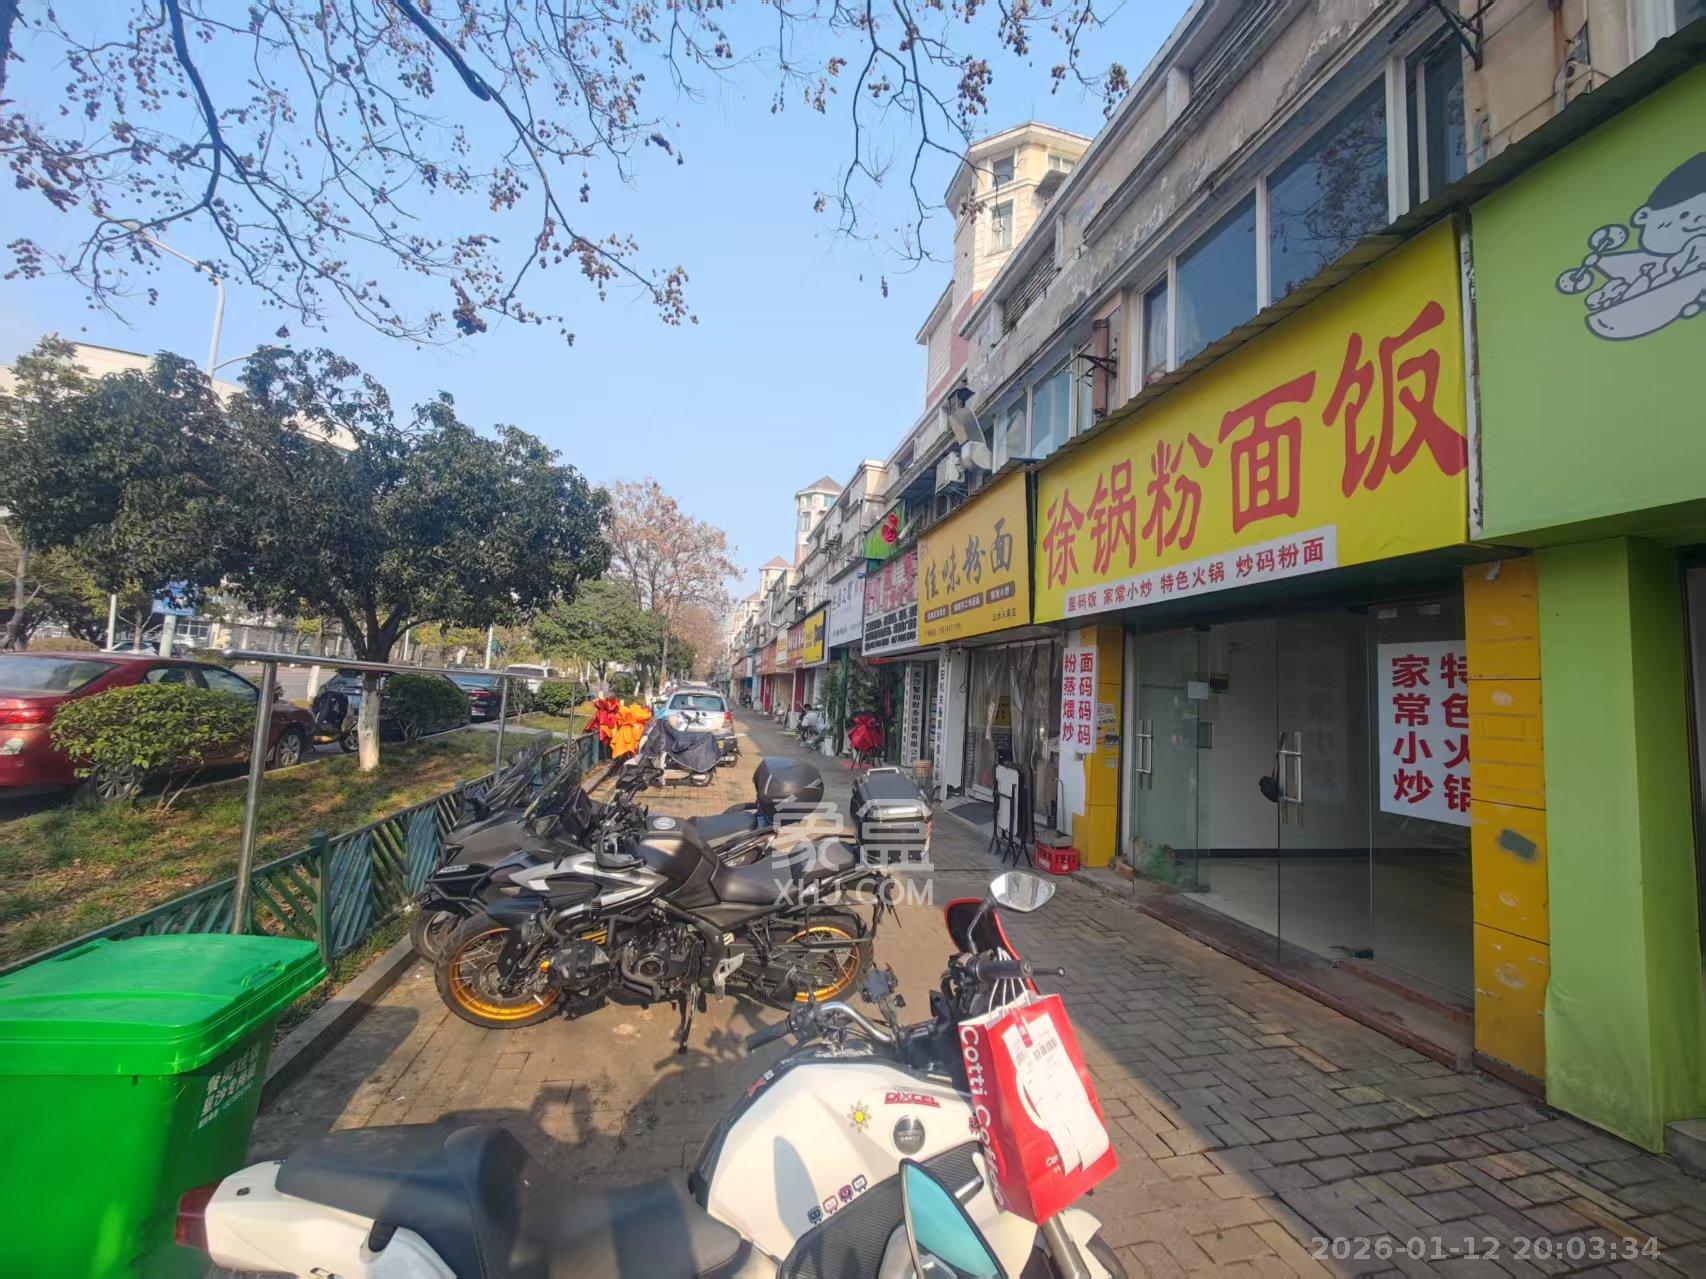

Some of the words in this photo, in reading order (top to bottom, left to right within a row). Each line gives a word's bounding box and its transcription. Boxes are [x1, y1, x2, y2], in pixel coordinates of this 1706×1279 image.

[1043, 300, 1468, 590] 徐锅粉面饭
[925, 517, 1014, 601] 佳味粉面
[1067, 590, 1098, 612] 盖码饭
[1103, 579, 1153, 605] 家常小炒
[1160, 560, 1225, 595] 特色火锅
[1235, 535, 1325, 578] 炒码粉面
[1391, 653, 1434, 804] 家常小炒
[959, 1025, 988, 1097] Cotti
